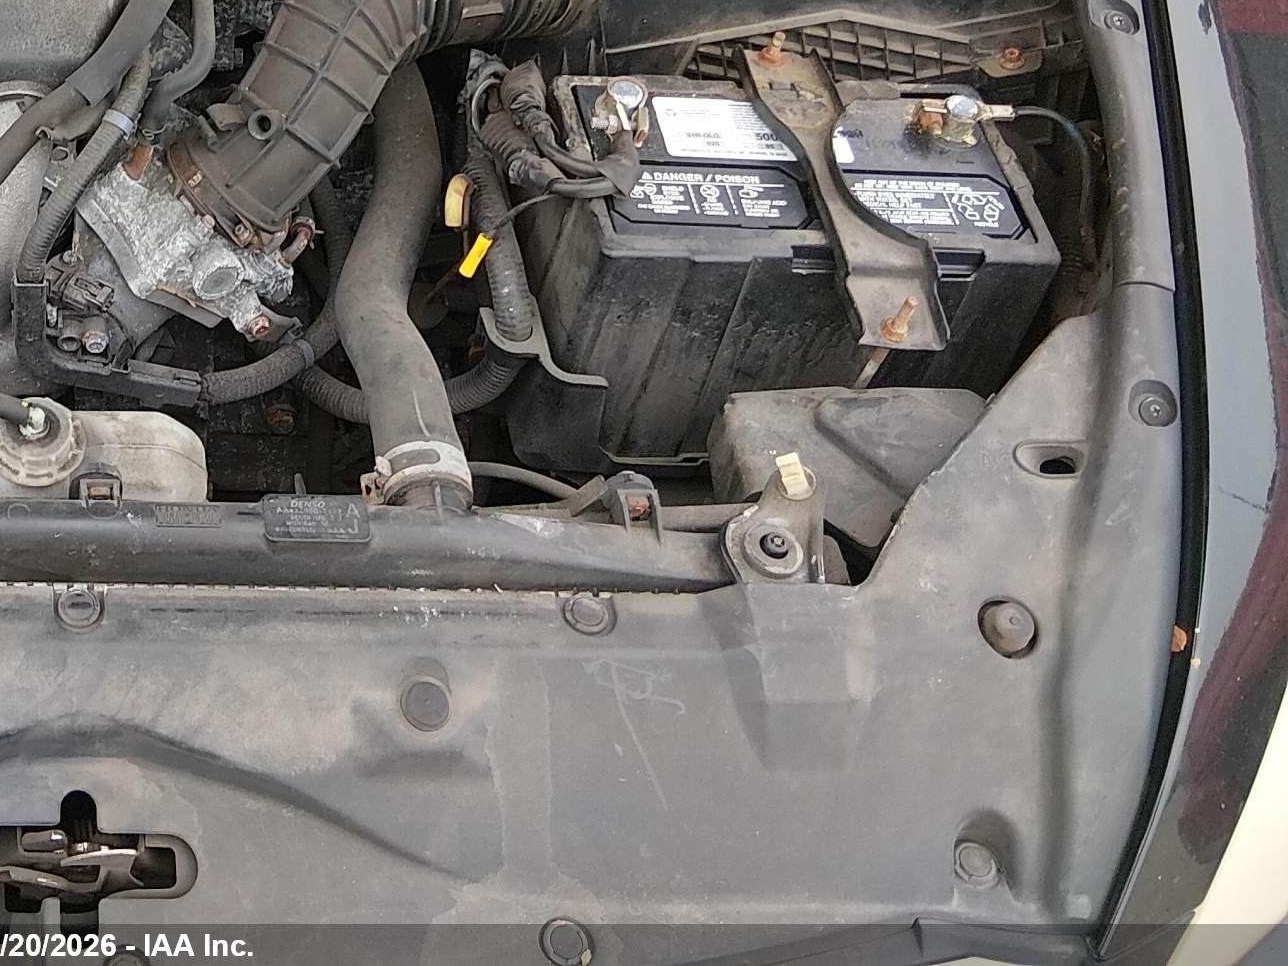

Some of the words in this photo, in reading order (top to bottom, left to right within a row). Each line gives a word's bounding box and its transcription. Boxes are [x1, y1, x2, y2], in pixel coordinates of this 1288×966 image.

[654, 172, 704, 182] DANGER
[715, 174, 760, 184] POISON
[290, 499, 326, 509] DENSO
[346, 503, 361, 518] A
